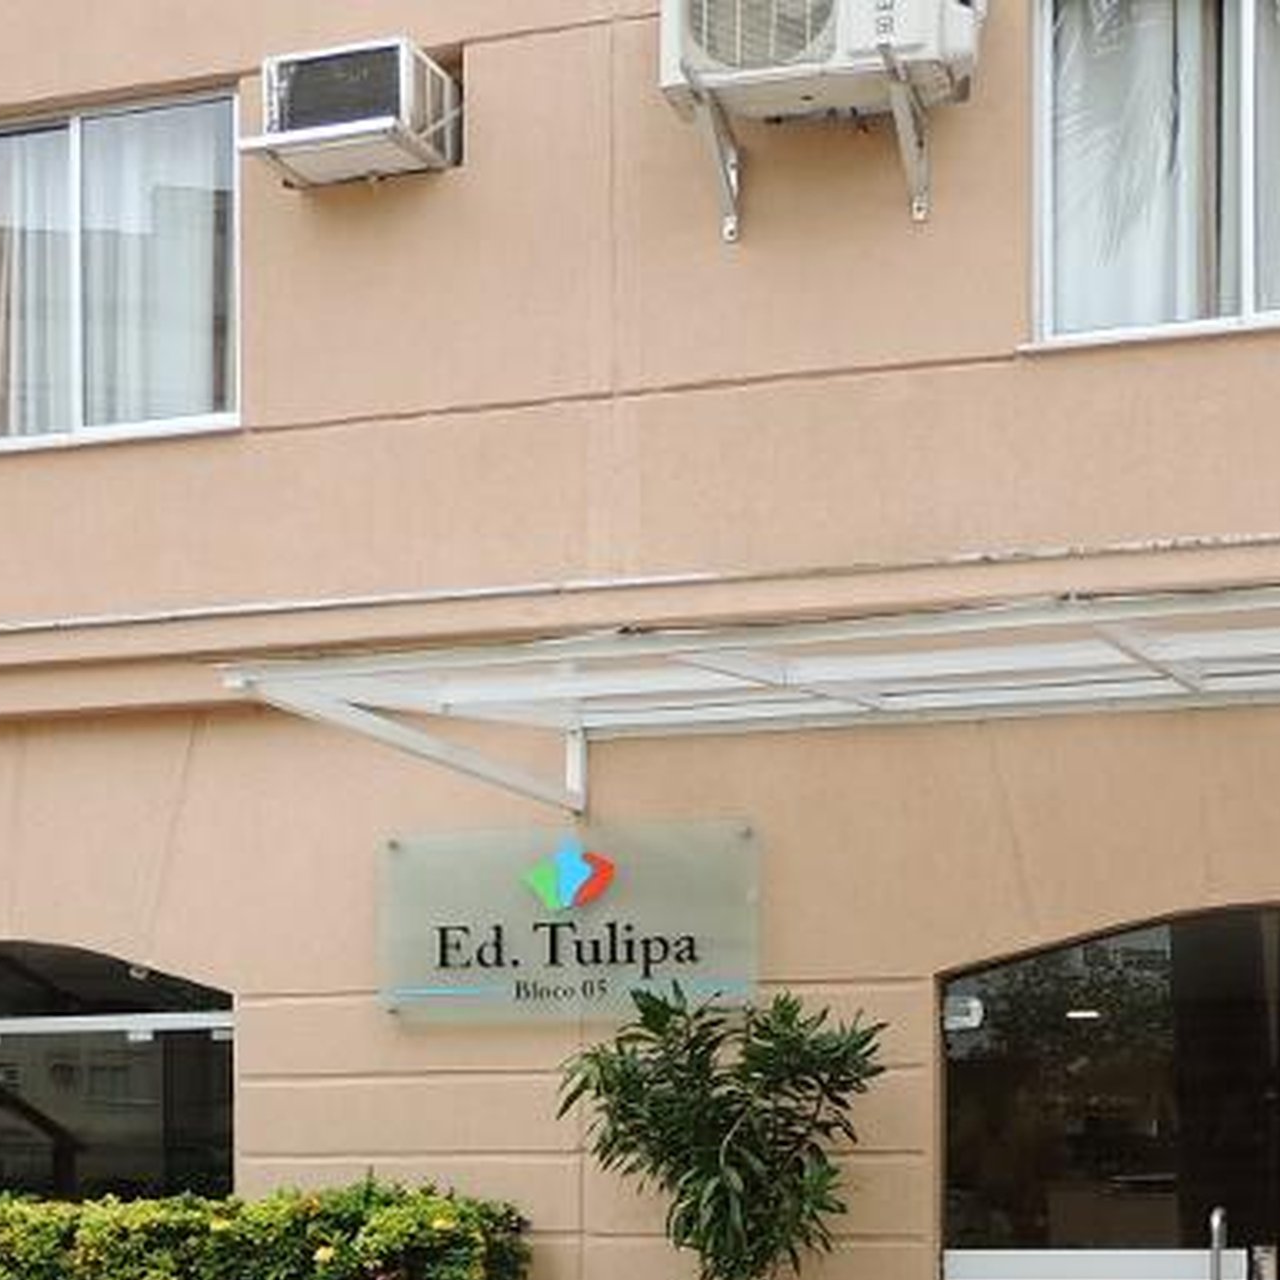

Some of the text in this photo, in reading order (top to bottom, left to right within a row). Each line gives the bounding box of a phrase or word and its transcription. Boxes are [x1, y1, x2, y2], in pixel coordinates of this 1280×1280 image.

[434, 920, 700, 980] Ed. Tulipa
[515, 977, 608, 1001] Bloco 05
